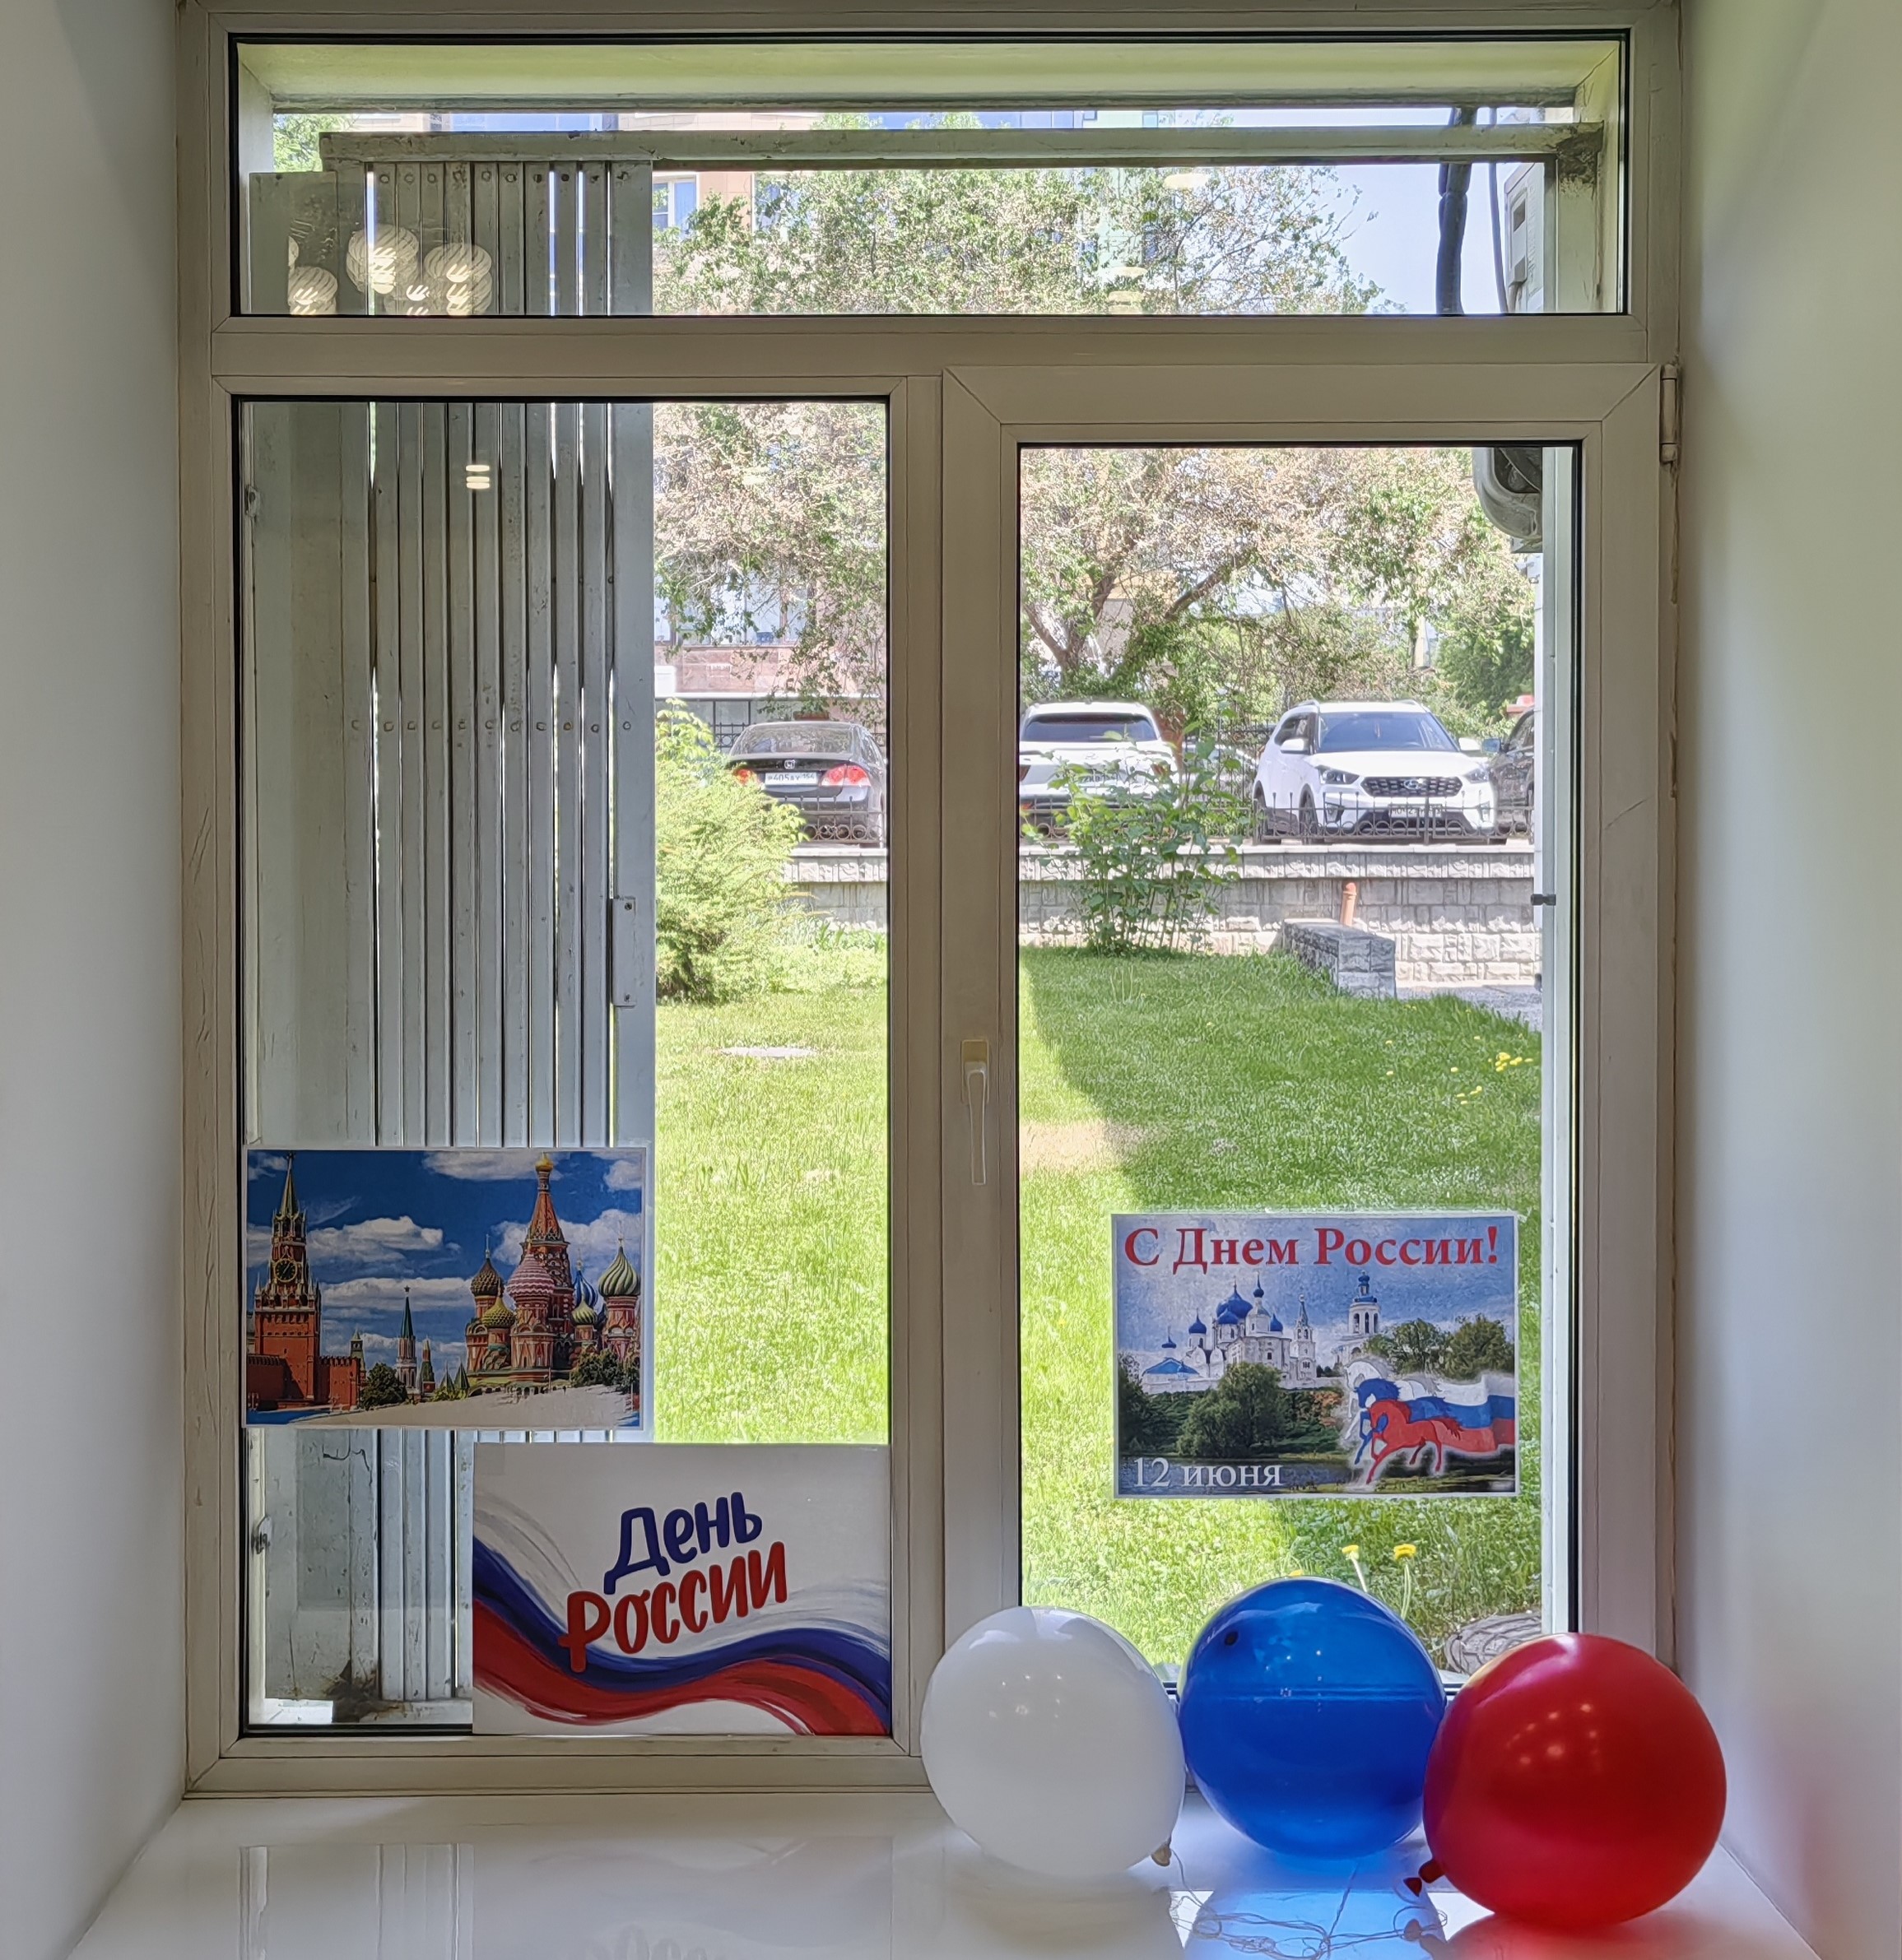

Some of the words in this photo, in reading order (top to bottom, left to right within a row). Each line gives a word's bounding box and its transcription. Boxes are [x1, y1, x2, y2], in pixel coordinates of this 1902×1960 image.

[1124, 1228, 1160, 1266] С
[1172, 1228, 1300, 1275] Днем
[1314, 1226, 1500, 1266] России!
[1132, 1457, 1170, 1488] 12
[1181, 1465, 1283, 1488] июня
[603, 1491, 763, 1595] День
[557, 1540, 788, 1673] России
